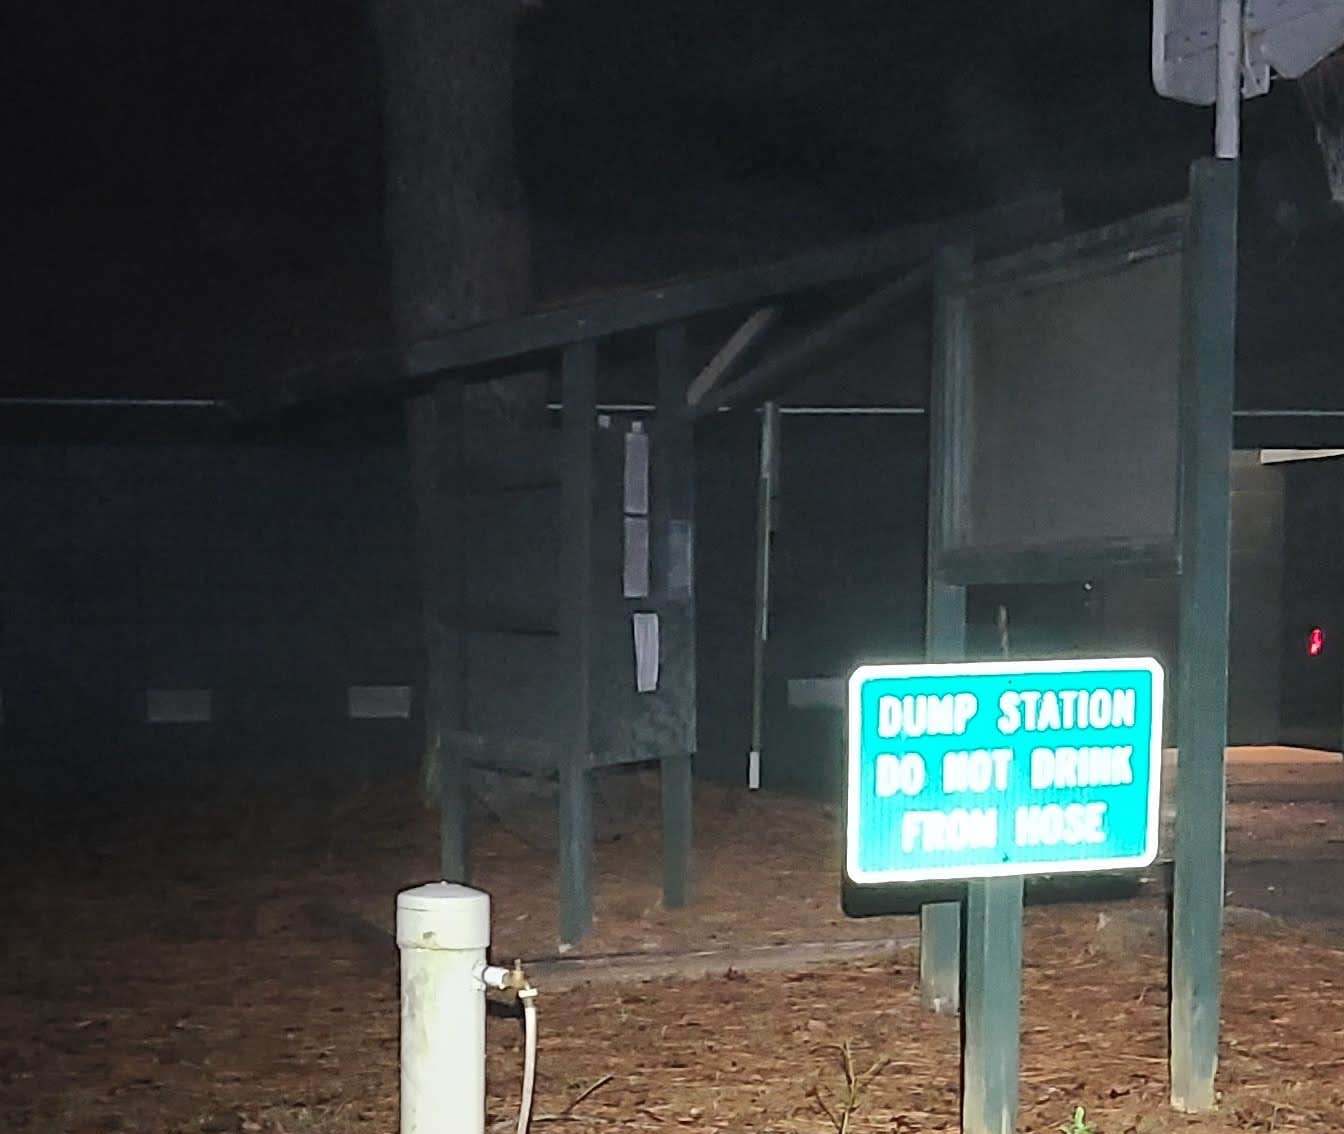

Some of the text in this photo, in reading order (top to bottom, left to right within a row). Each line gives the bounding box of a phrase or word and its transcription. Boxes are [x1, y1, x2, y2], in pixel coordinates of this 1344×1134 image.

[877, 687, 1136, 739] DUMP STATION
[874, 744, 1134, 797] DO NOT DRINK
[901, 801, 1107, 853] FROM HOSE
